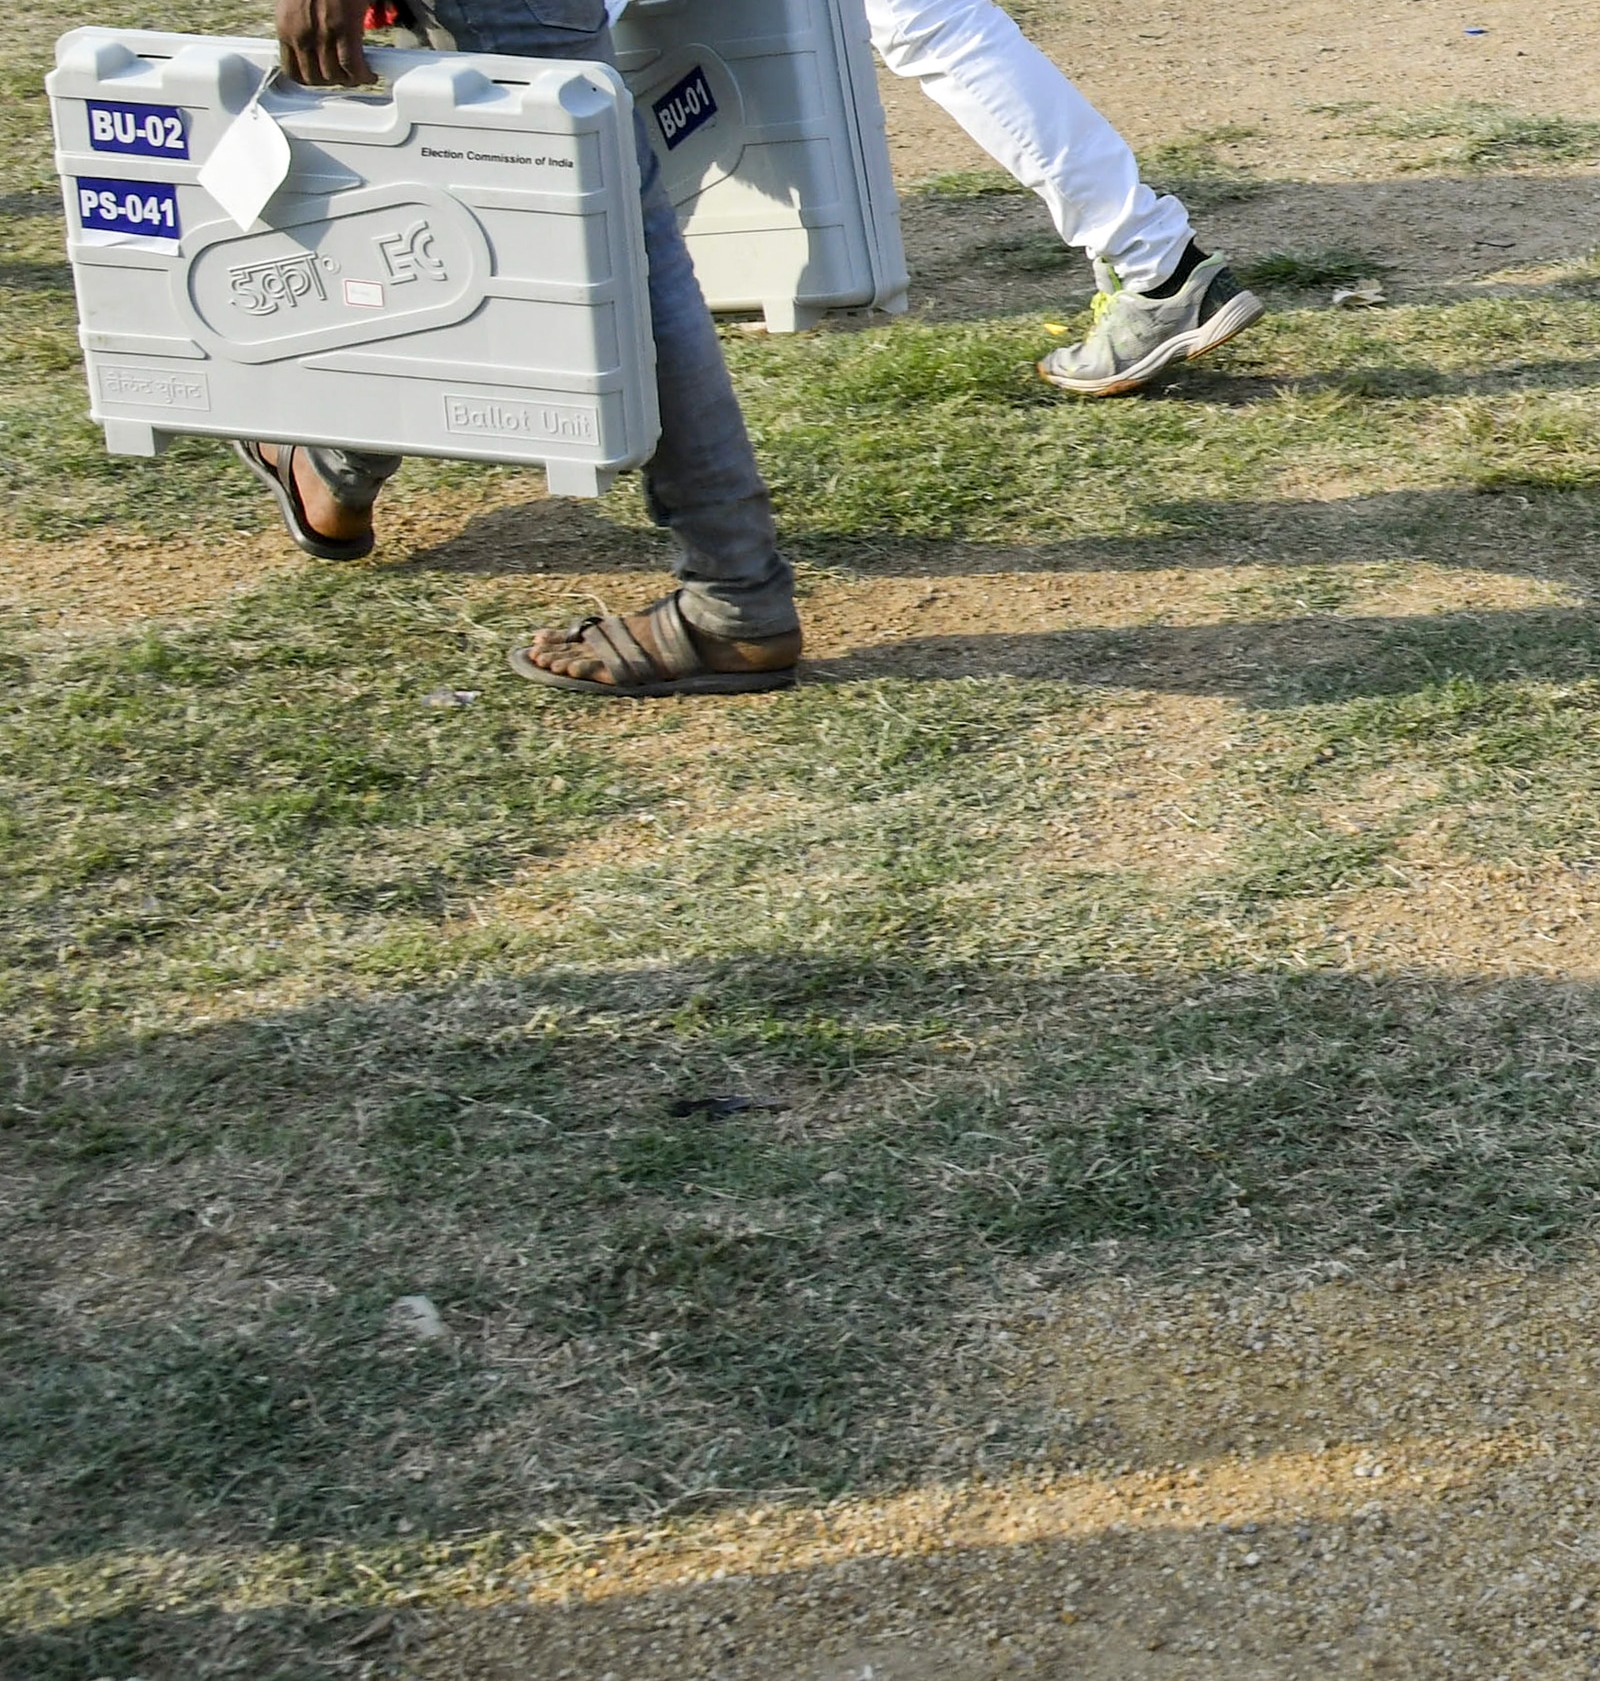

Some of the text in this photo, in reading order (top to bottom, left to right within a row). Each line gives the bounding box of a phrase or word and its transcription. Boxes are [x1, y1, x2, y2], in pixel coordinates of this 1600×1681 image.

[659, 78, 710, 138] BU-01
[91, 109, 185, 149] BU-02
[421, 146, 574, 168] Election Commission of India
[80, 189, 175, 227] PS-041
[453, 402, 592, 438] Ballot Unit
